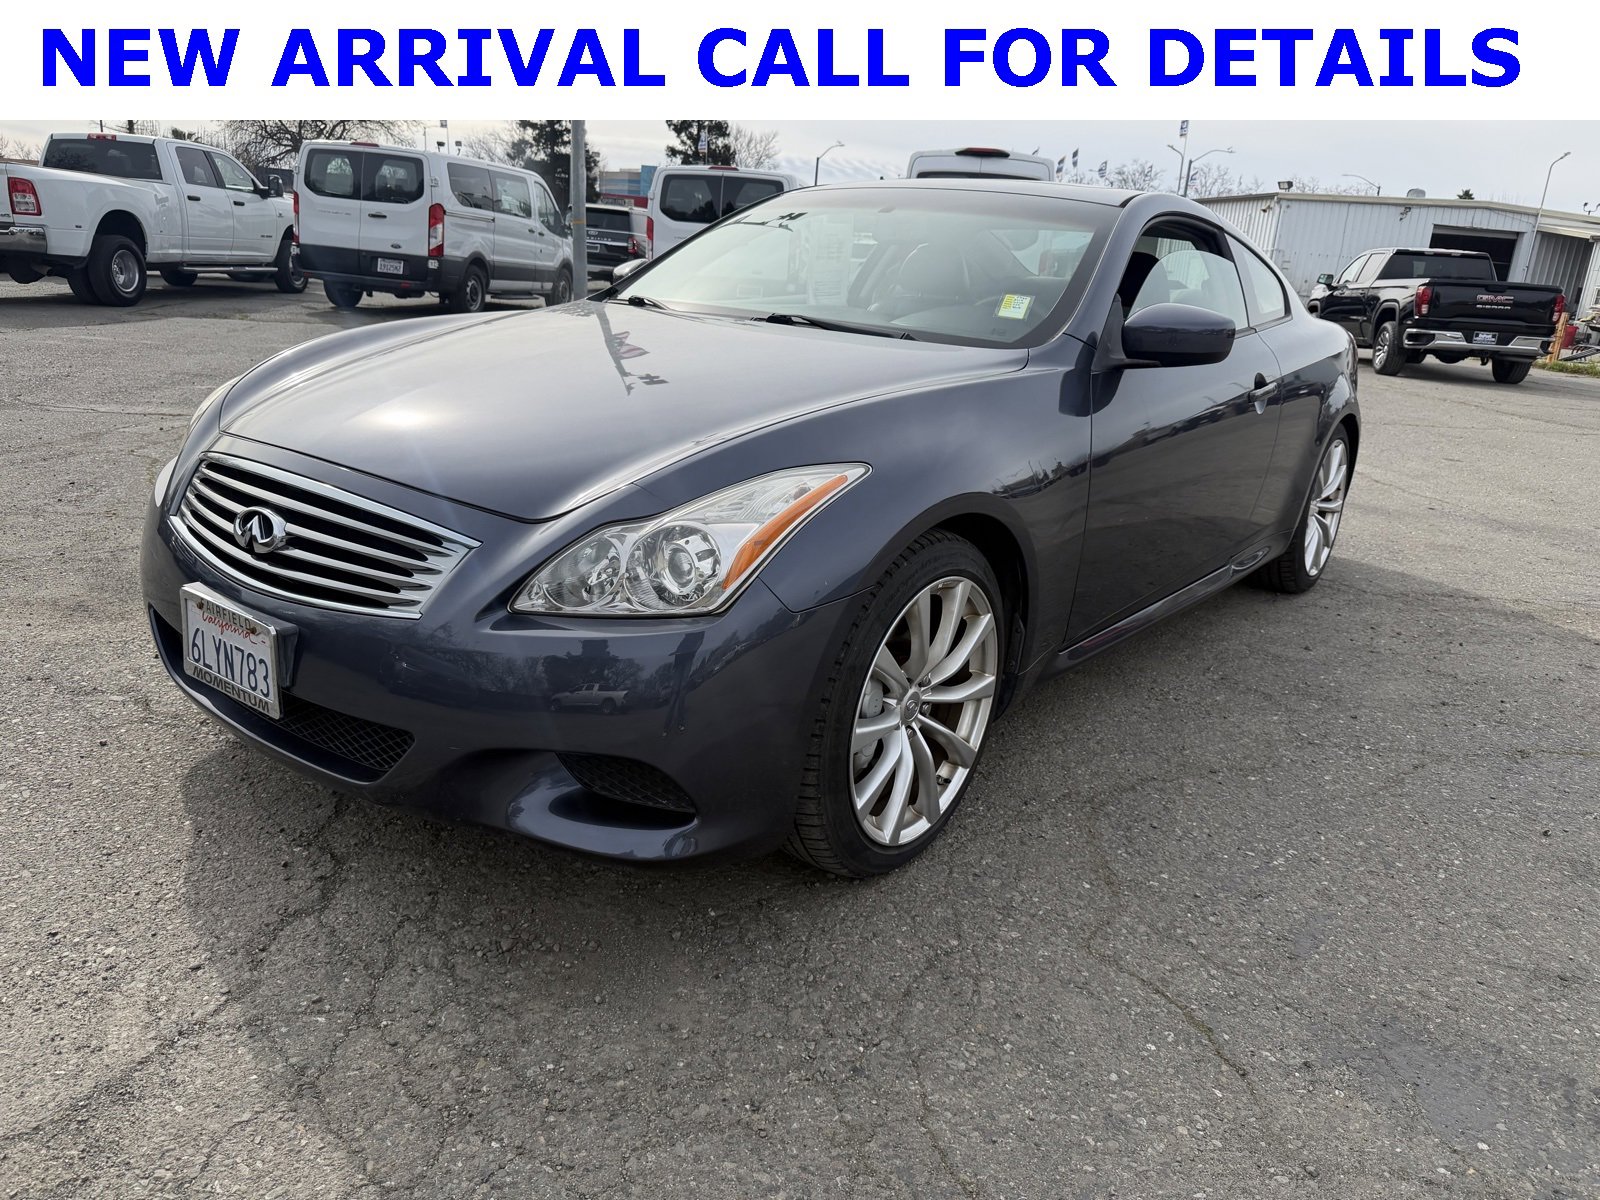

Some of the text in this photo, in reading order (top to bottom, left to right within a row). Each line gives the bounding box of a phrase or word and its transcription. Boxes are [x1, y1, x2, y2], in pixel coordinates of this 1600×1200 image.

[1477, 294, 1514, 304] GMC
[191, 627, 270, 698] 6LYN783
[192, 665, 270, 713] MOMENTUM
